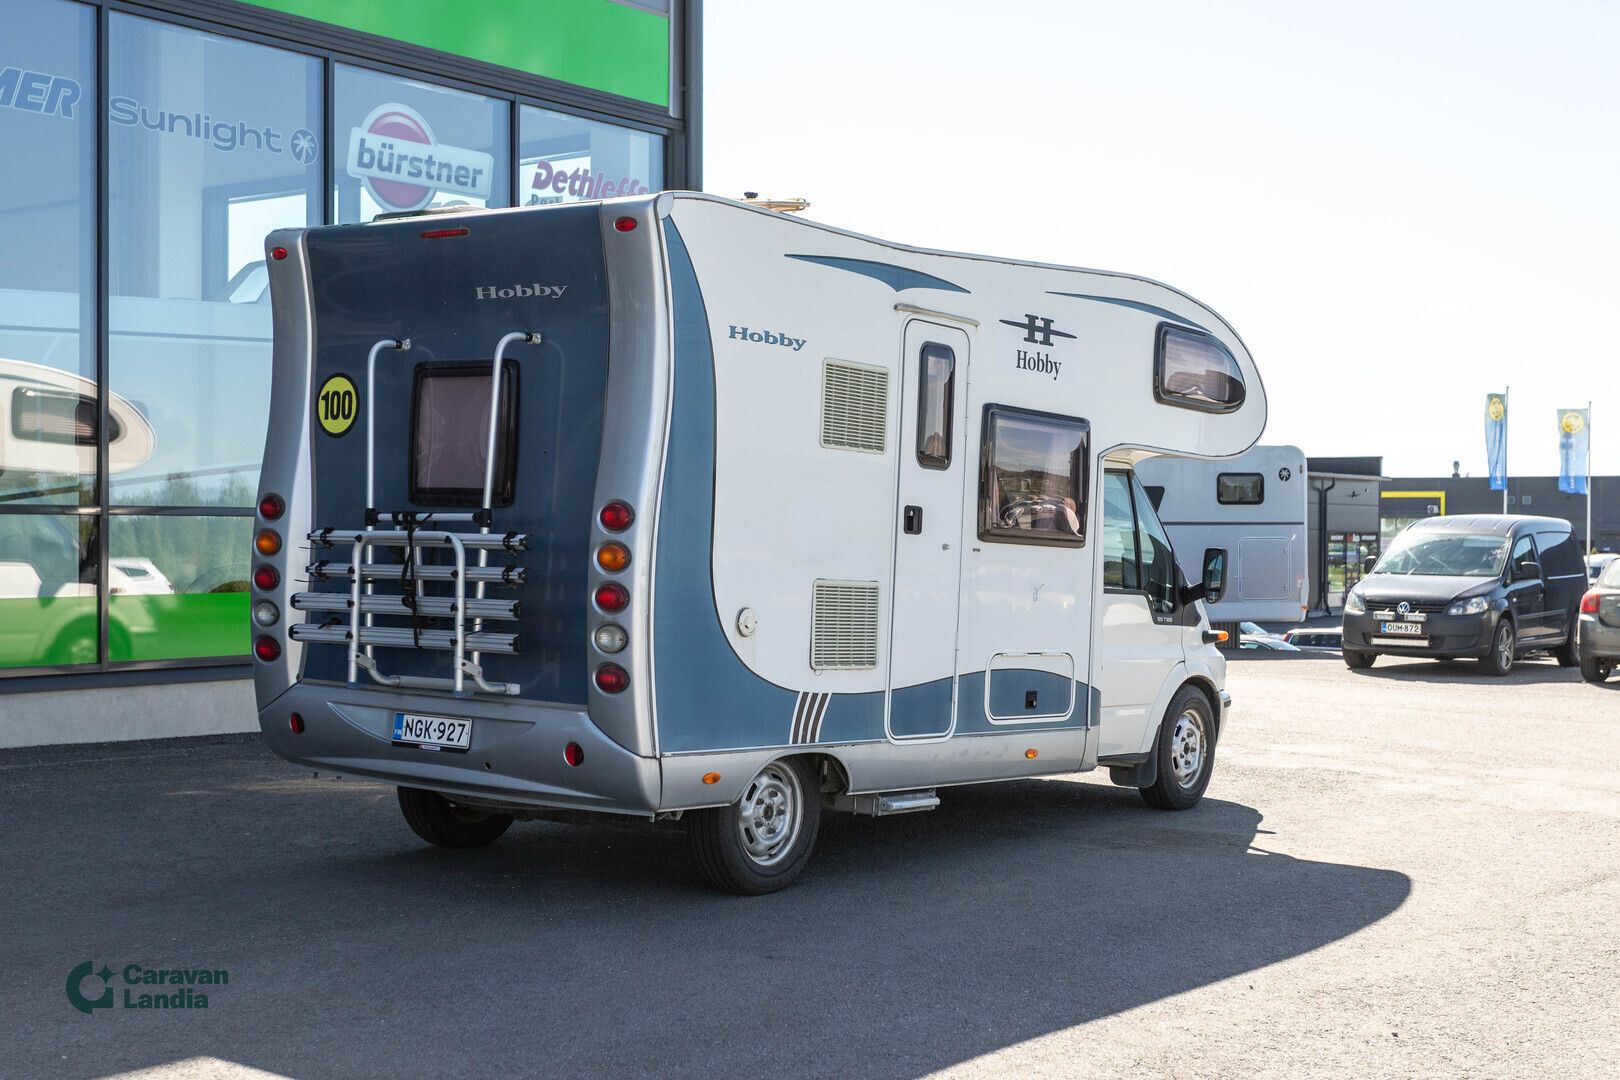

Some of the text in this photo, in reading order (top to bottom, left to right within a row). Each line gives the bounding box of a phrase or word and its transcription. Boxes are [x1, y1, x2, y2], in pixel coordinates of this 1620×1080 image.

[109, 97, 283, 154] Sunlight
[356, 138, 483, 188] bürstner
[475, 283, 568, 299] Hobby
[728, 325, 807, 352] Hobby
[1016, 349, 1062, 381] Hobby
[320, 390, 353, 420] 100
[404, 718, 467, 743] NGK-927
